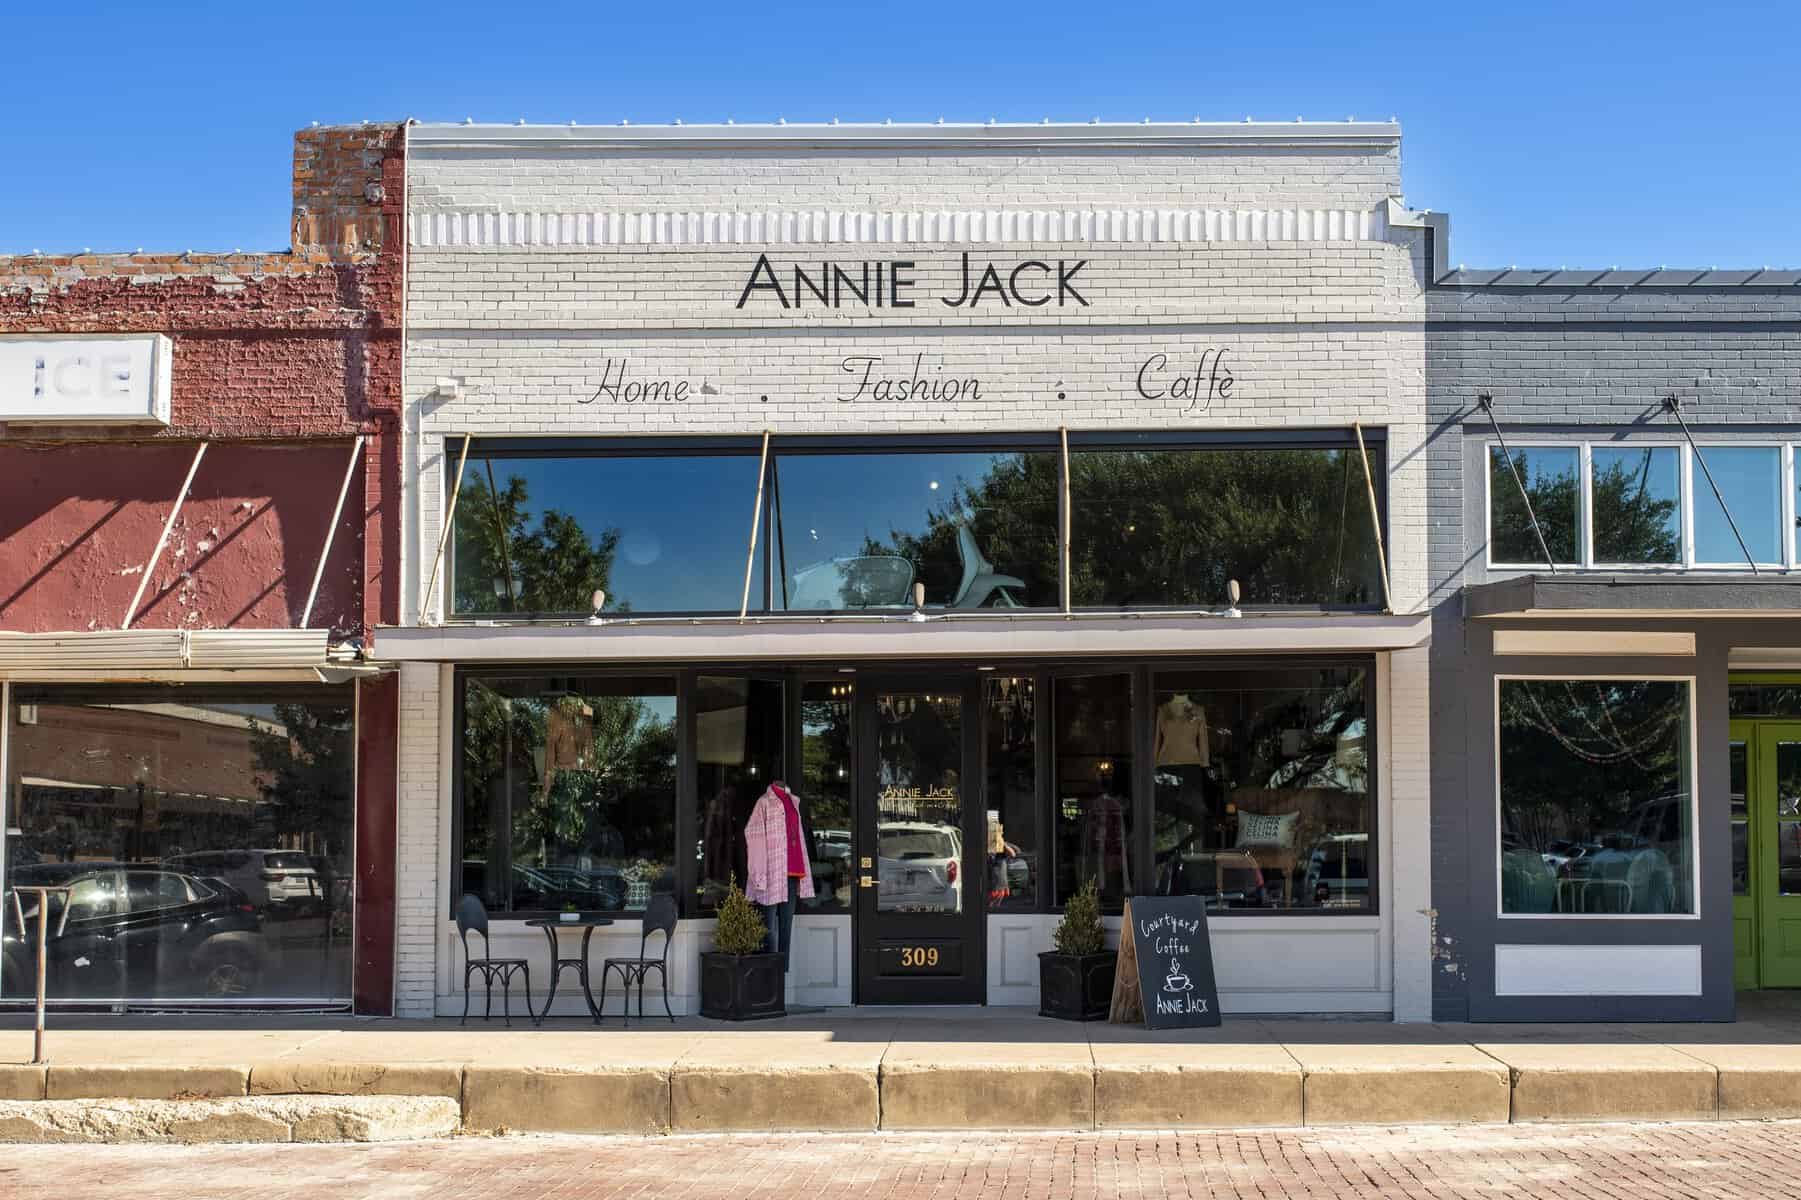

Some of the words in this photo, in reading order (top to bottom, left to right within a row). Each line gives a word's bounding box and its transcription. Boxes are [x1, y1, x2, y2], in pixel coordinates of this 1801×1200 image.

[735, 253, 915, 309] ANNIE
[942, 252, 1090, 308] JACK
[577, 358, 689, 403] Home
[837, 352, 982, 402] Fashion
[1137, 348, 1234, 412] Caffè
[1140, 913, 1199, 937] Courtyard
[901, 947, 939, 967] 309
[1155, 937, 1190, 955] Coffee
[1156, 993, 1184, 1014] ANNIE
[1185, 992, 1209, 1013] JACK
